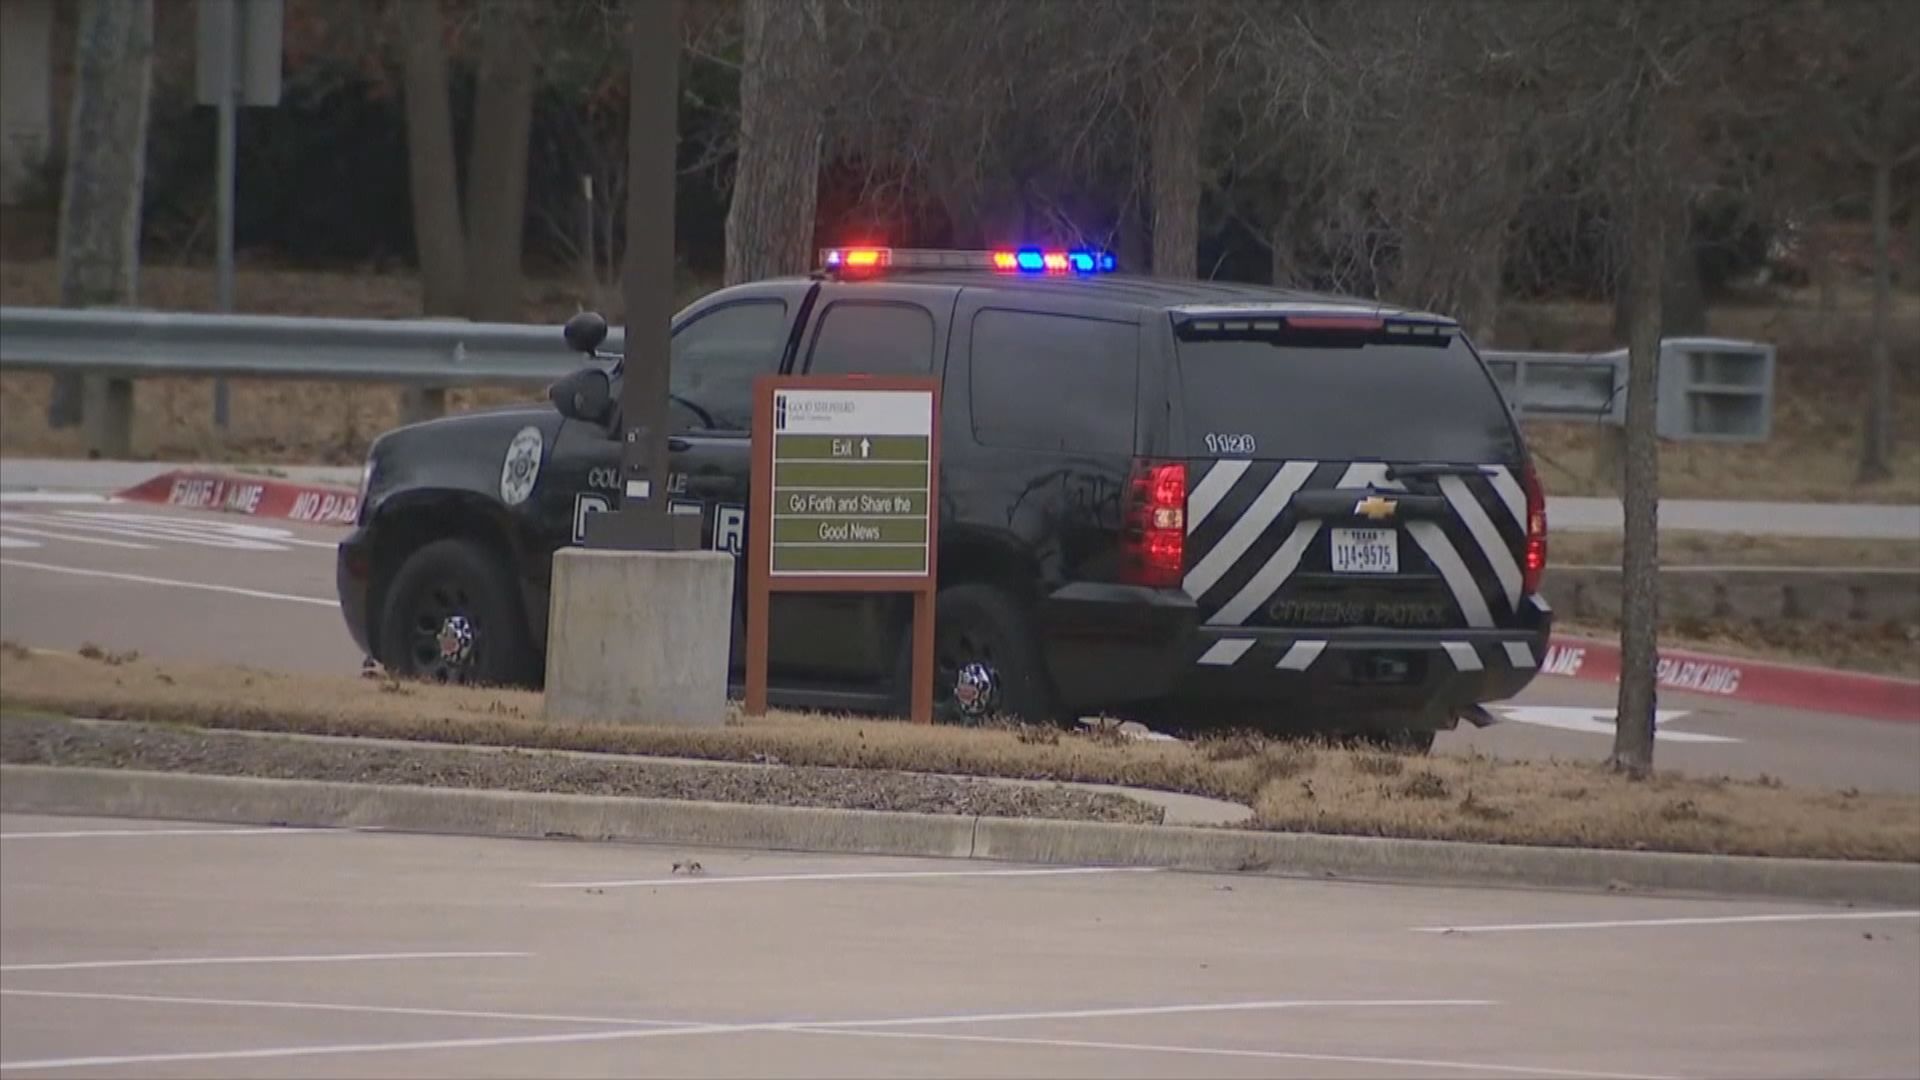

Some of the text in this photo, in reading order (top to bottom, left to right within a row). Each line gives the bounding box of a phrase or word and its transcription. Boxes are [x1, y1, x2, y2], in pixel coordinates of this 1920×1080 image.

[832, 438, 853, 456] Exit
[1204, 433, 1256, 453] 1128
[168, 479, 214, 506] FIRE
[289, 491, 320, 520] NO
[790, 494, 911, 513] Go Forth and Share the
[819, 522, 880, 540] Good News
[1351, 532, 1377, 540] TEXAS
[1540, 645, 1586, 676] ANE
[1656, 657, 1742, 694] PARKING
